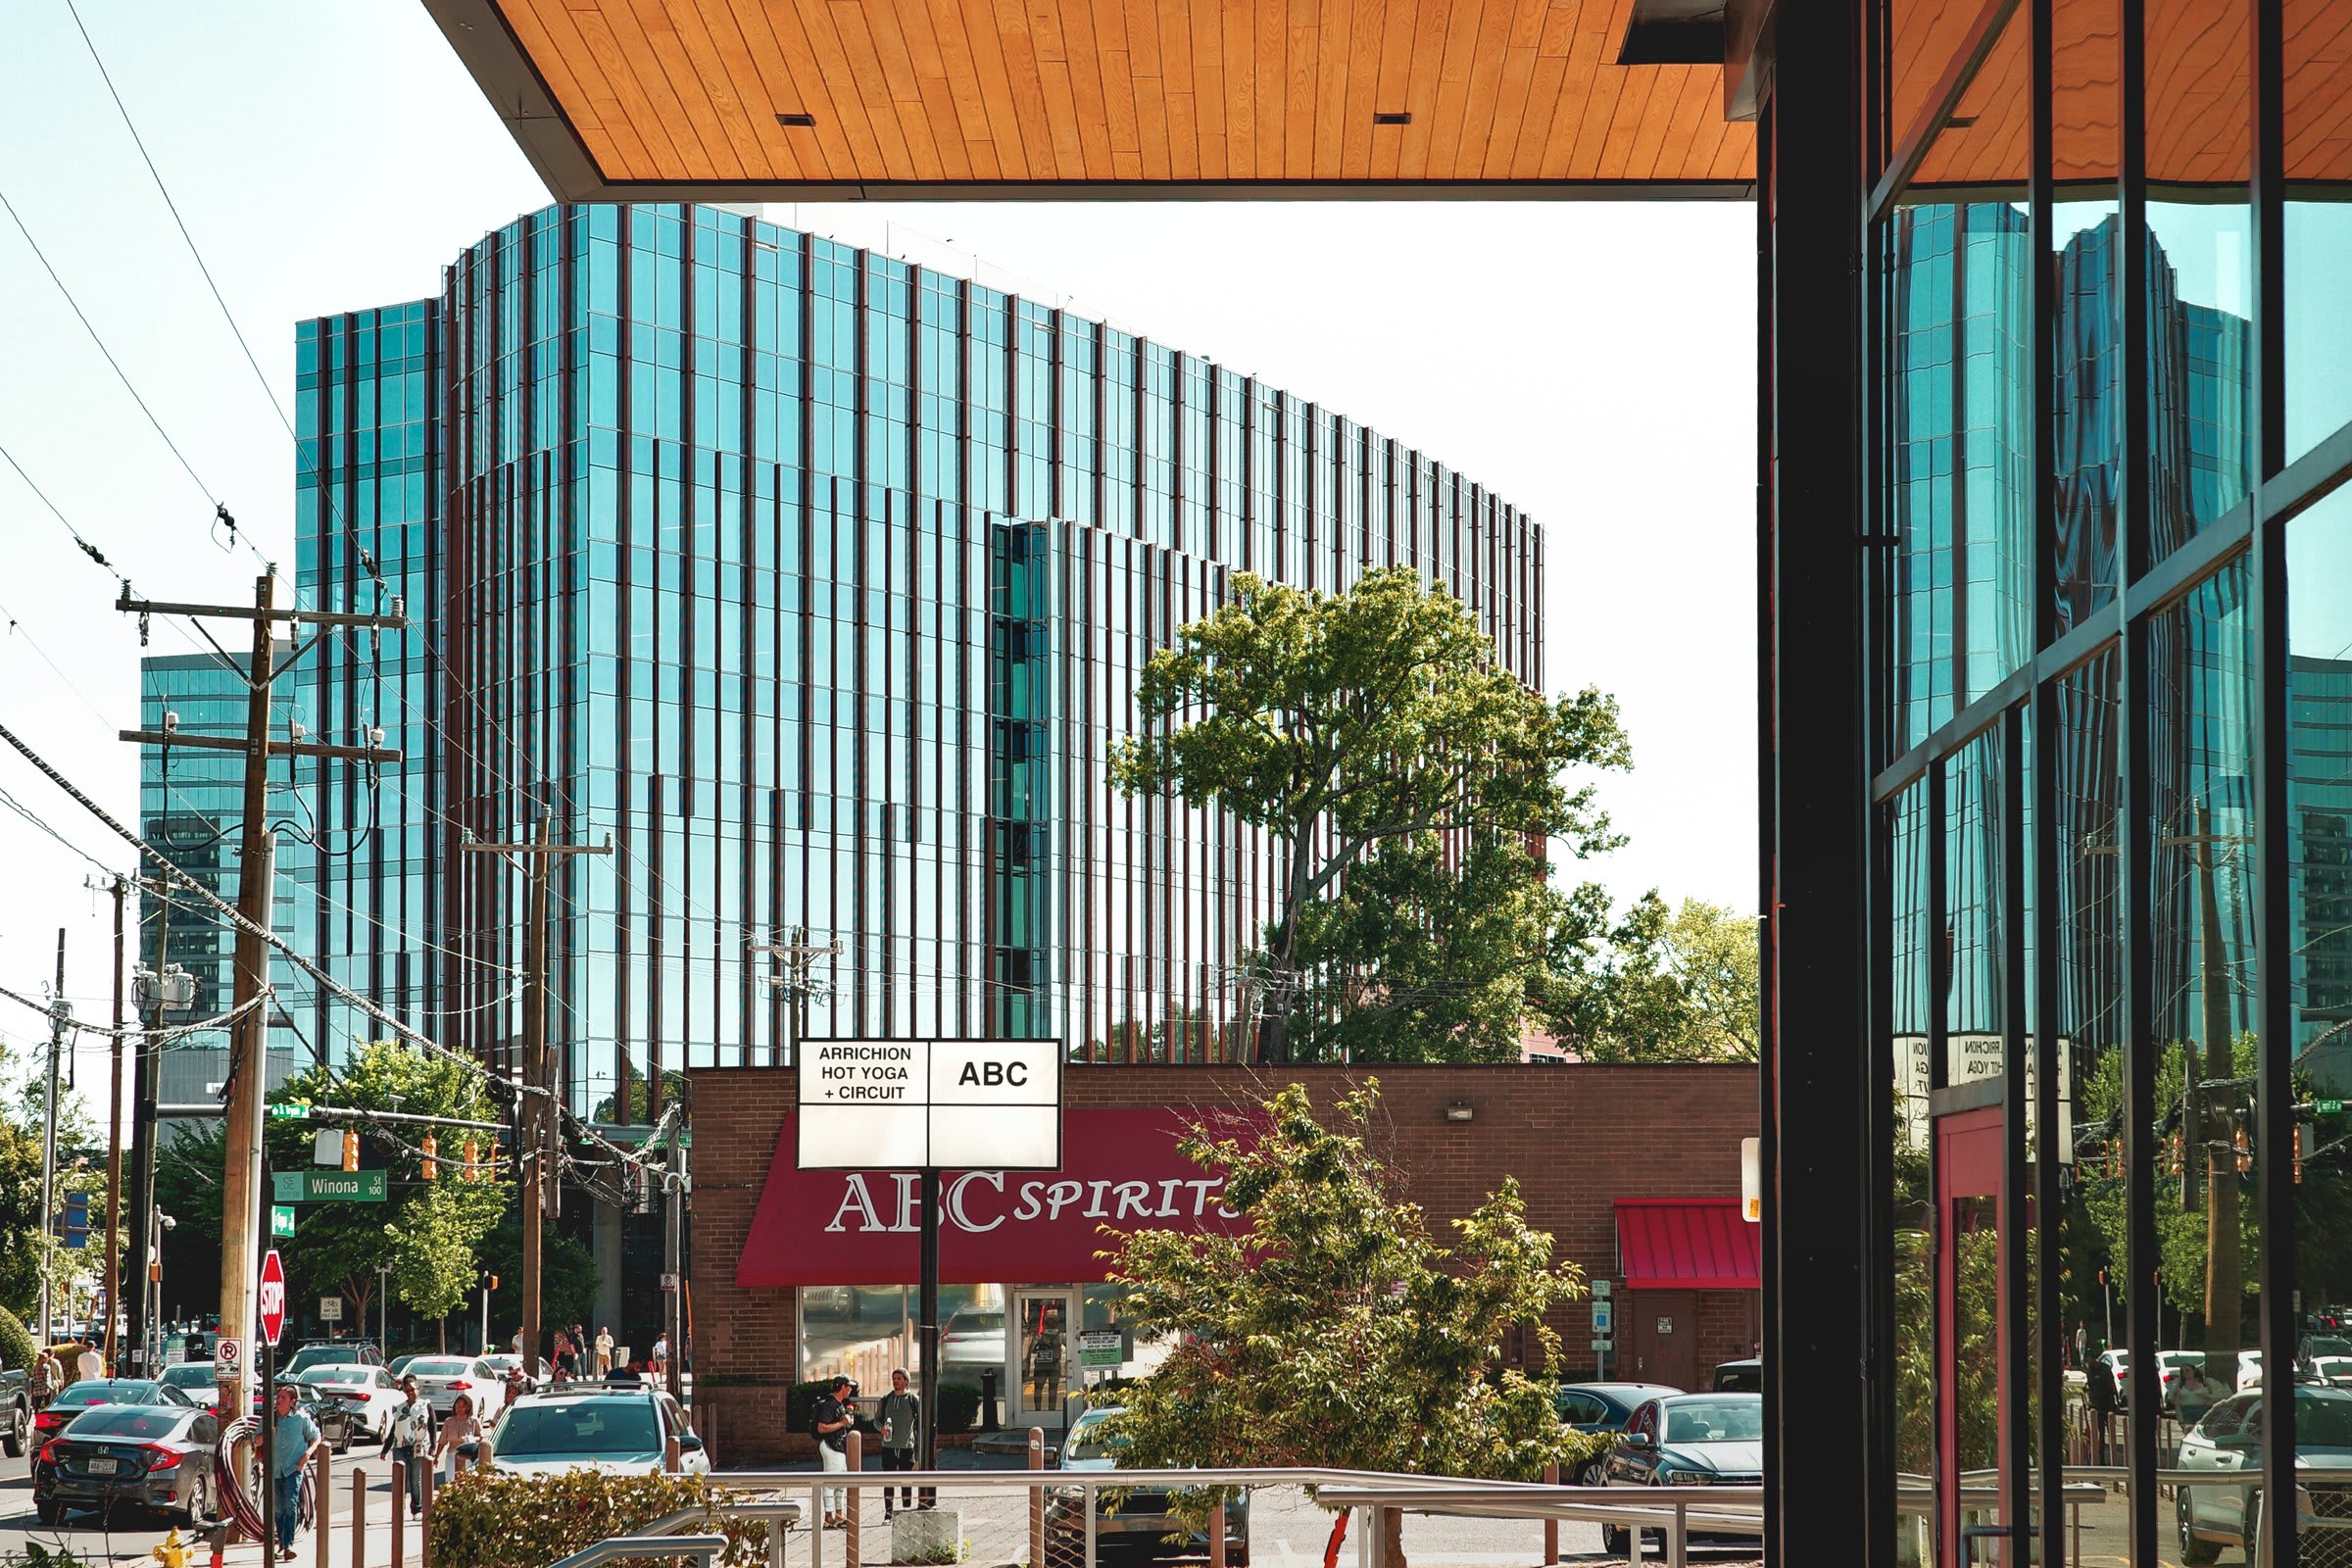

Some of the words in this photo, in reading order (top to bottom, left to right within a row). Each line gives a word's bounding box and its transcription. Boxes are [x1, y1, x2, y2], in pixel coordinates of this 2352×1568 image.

[819, 1048, 911, 1059] ARRICHION
[822, 1067, 856, 1079] HOT
[861, 1067, 908, 1079] YOGA
[958, 1061, 1028, 1087] ABC
[839, 1087, 906, 1099] CIRCUIT
[283, 1176, 295, 1191] SE
[312, 1179, 359, 1194] Winona
[374, 1176, 381, 1186] St
[824, 1171, 1005, 1233] ABC
[263, 1281, 282, 1315] STOP
